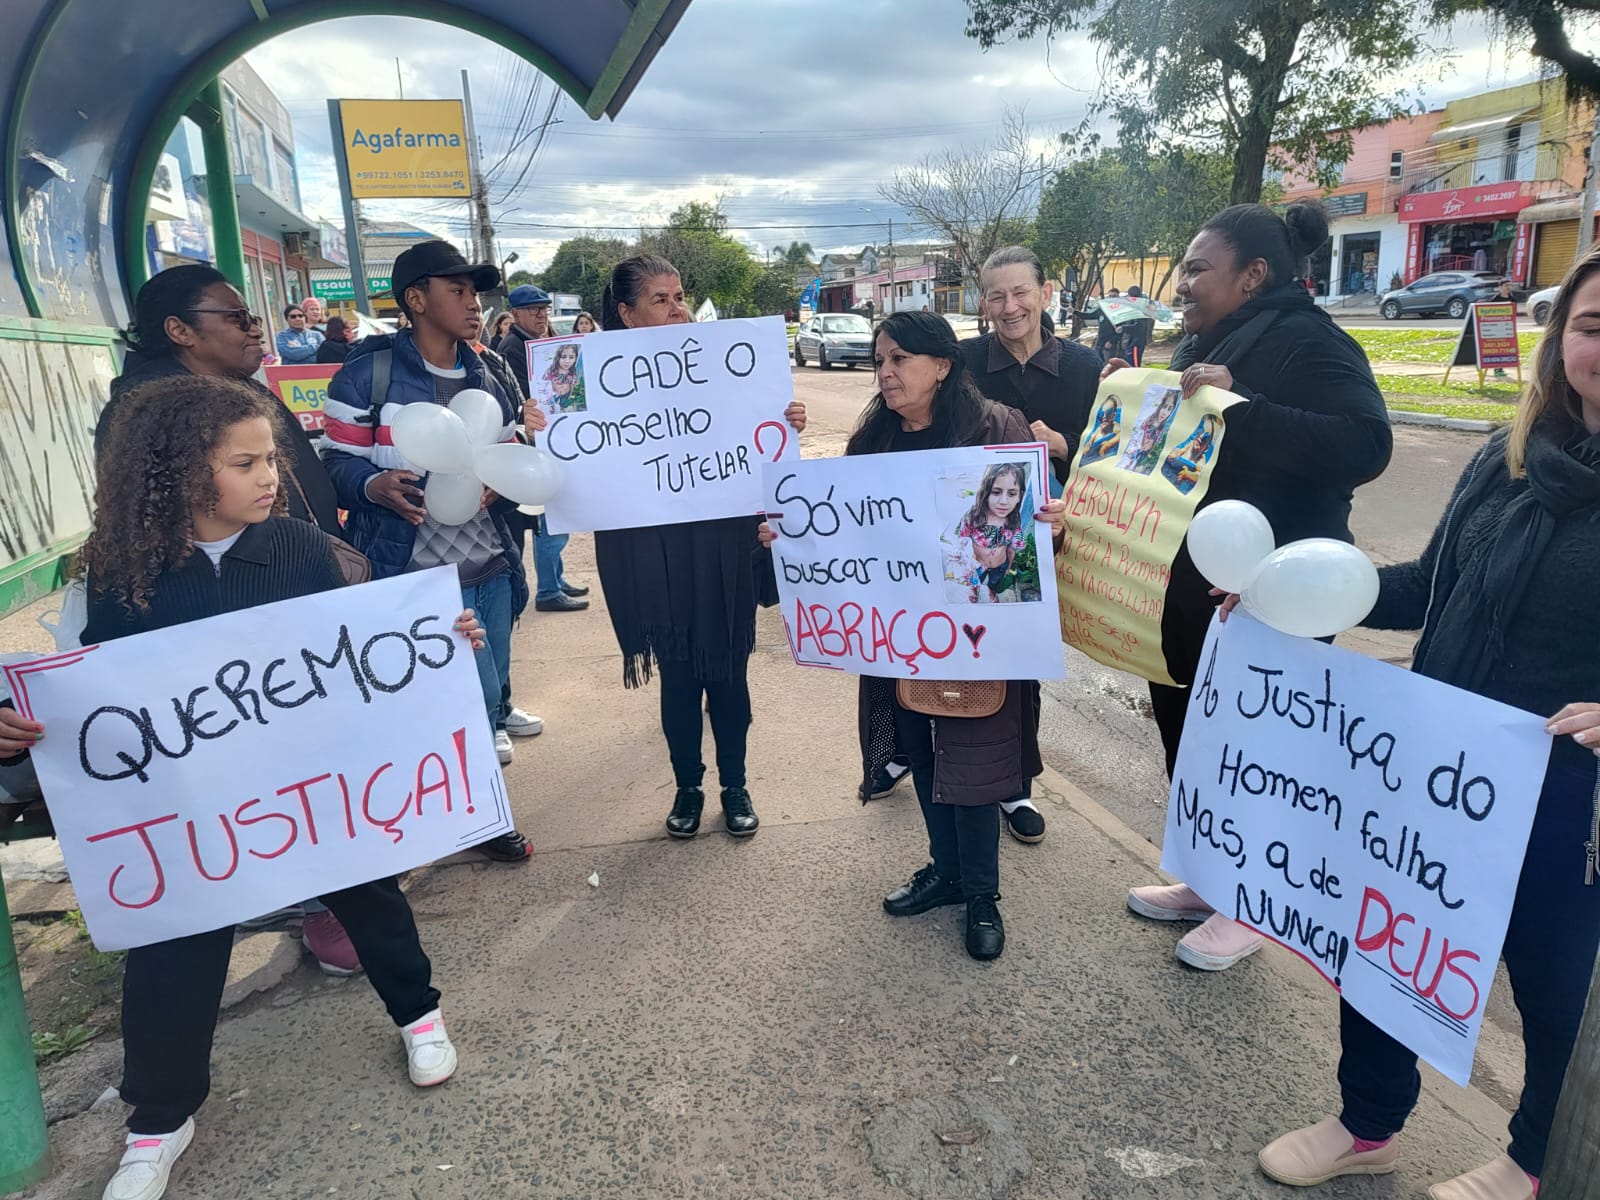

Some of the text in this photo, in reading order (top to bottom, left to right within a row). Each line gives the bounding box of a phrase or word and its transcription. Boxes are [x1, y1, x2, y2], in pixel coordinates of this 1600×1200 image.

[352, 127, 461, 154] Agafarma
[316, 281, 353, 289] ESQUI
[292, 385, 327, 408] Aga
[599, 337, 756, 398] CADÊ O
[298, 413, 325, 432] Pr
[775, 474, 914, 537] Só vim
[781, 556, 929, 585] buscar um
[1055, 558, 1074, 584] AS
[78, 614, 456, 783] QUEREMOS
[1237, 664, 1401, 792] Justiça
[1427, 751, 1496, 821] do
[86, 727, 477, 910] JUSTIÇA!
[1360, 810, 1464, 909] falha
[1177, 779, 1481, 1021] Mas, a de DEUS
[1235, 883, 1349, 988] NUNCA!
